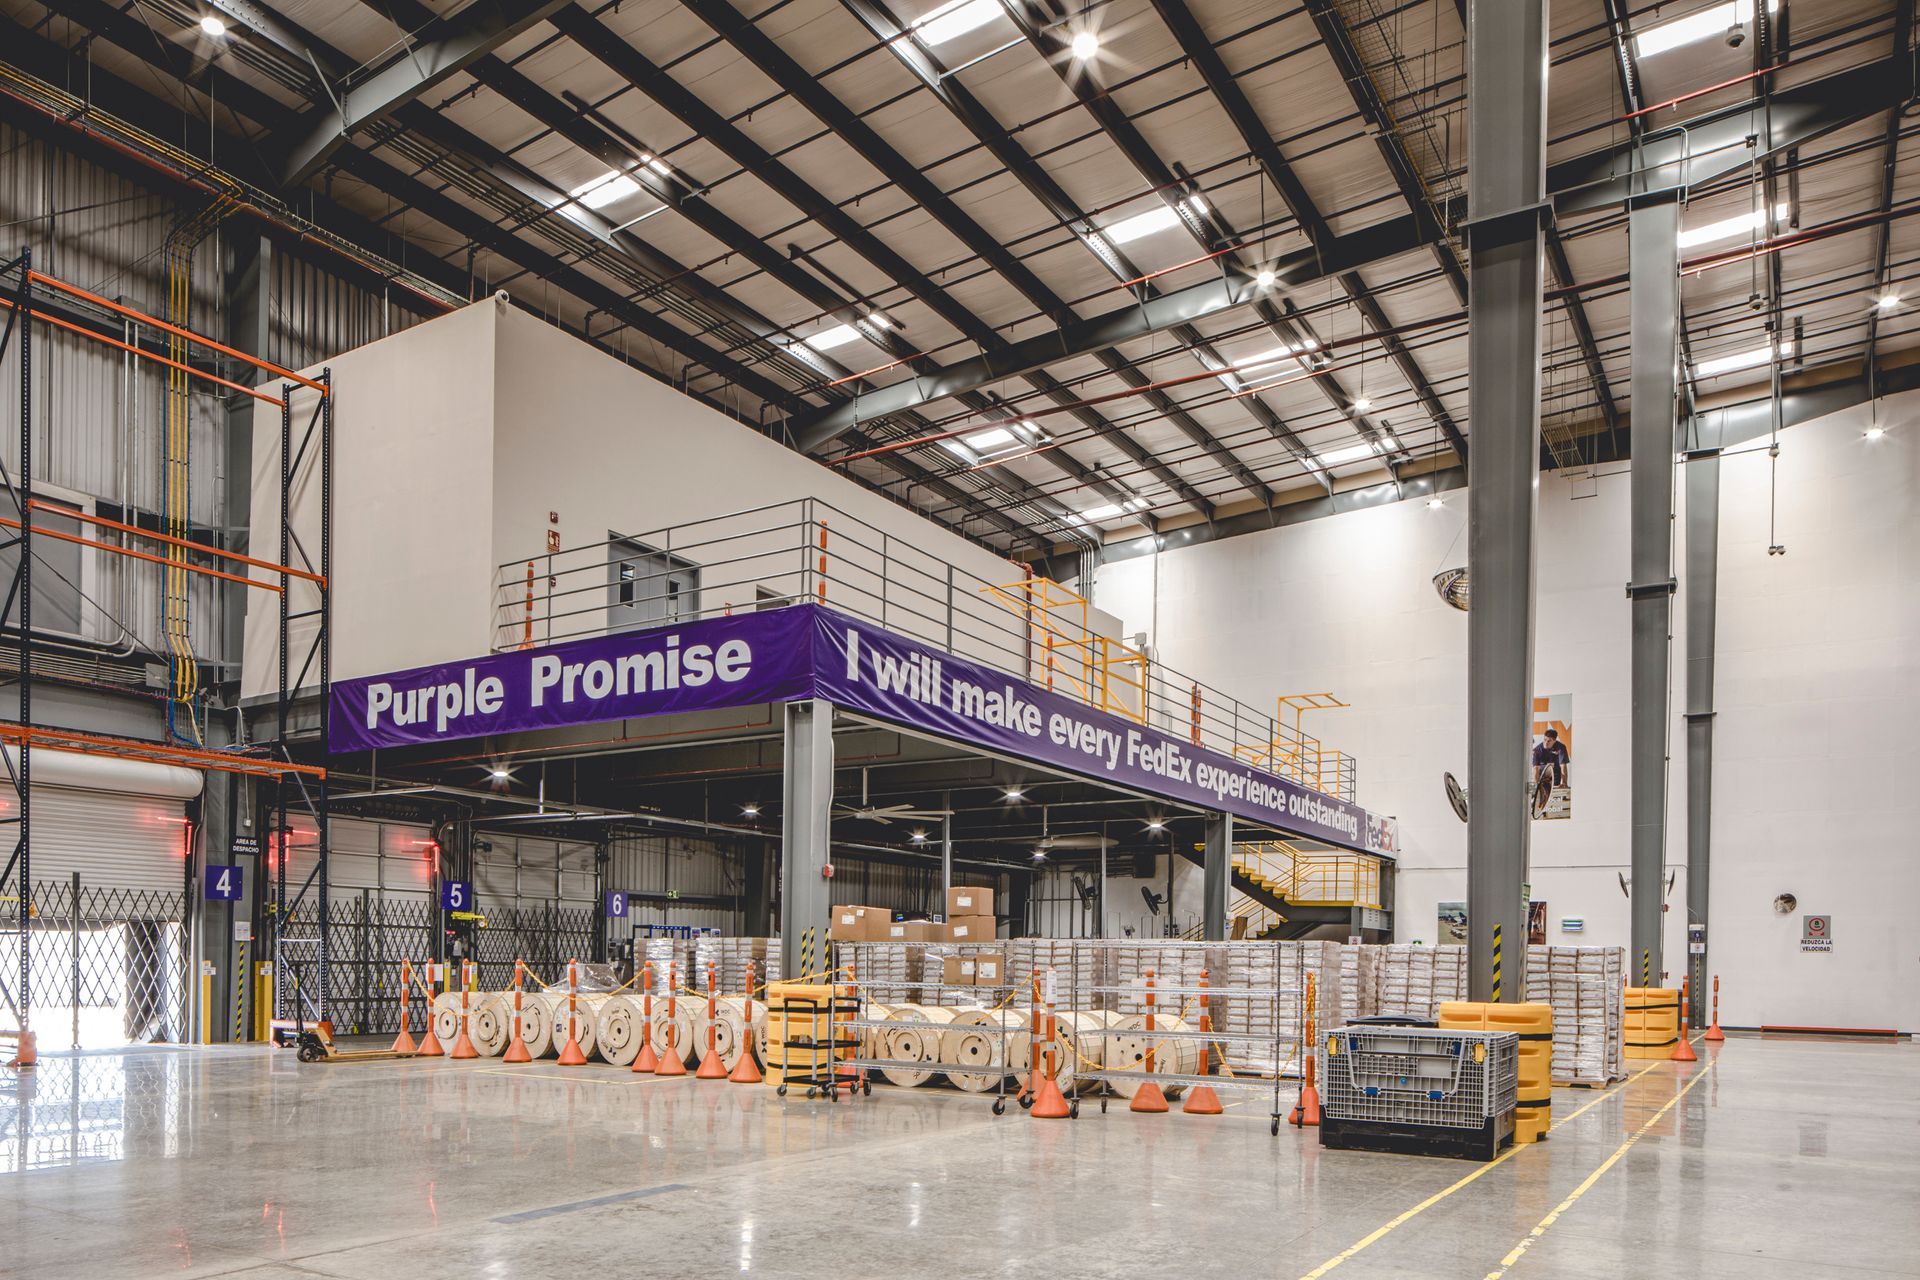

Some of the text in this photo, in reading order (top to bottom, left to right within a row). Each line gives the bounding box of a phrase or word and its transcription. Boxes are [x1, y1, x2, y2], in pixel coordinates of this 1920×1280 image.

[367, 635, 752, 732] Purple Promise
[846, 628, 1358, 841] I will make every FedEx experience outstanding
[1366, 813, 1394, 852] FedEx
[232, 845, 259, 853] DESPACHO
[216, 868, 231, 897] 4
[450, 883, 463, 908] 5
[612, 894, 622, 915] 6
